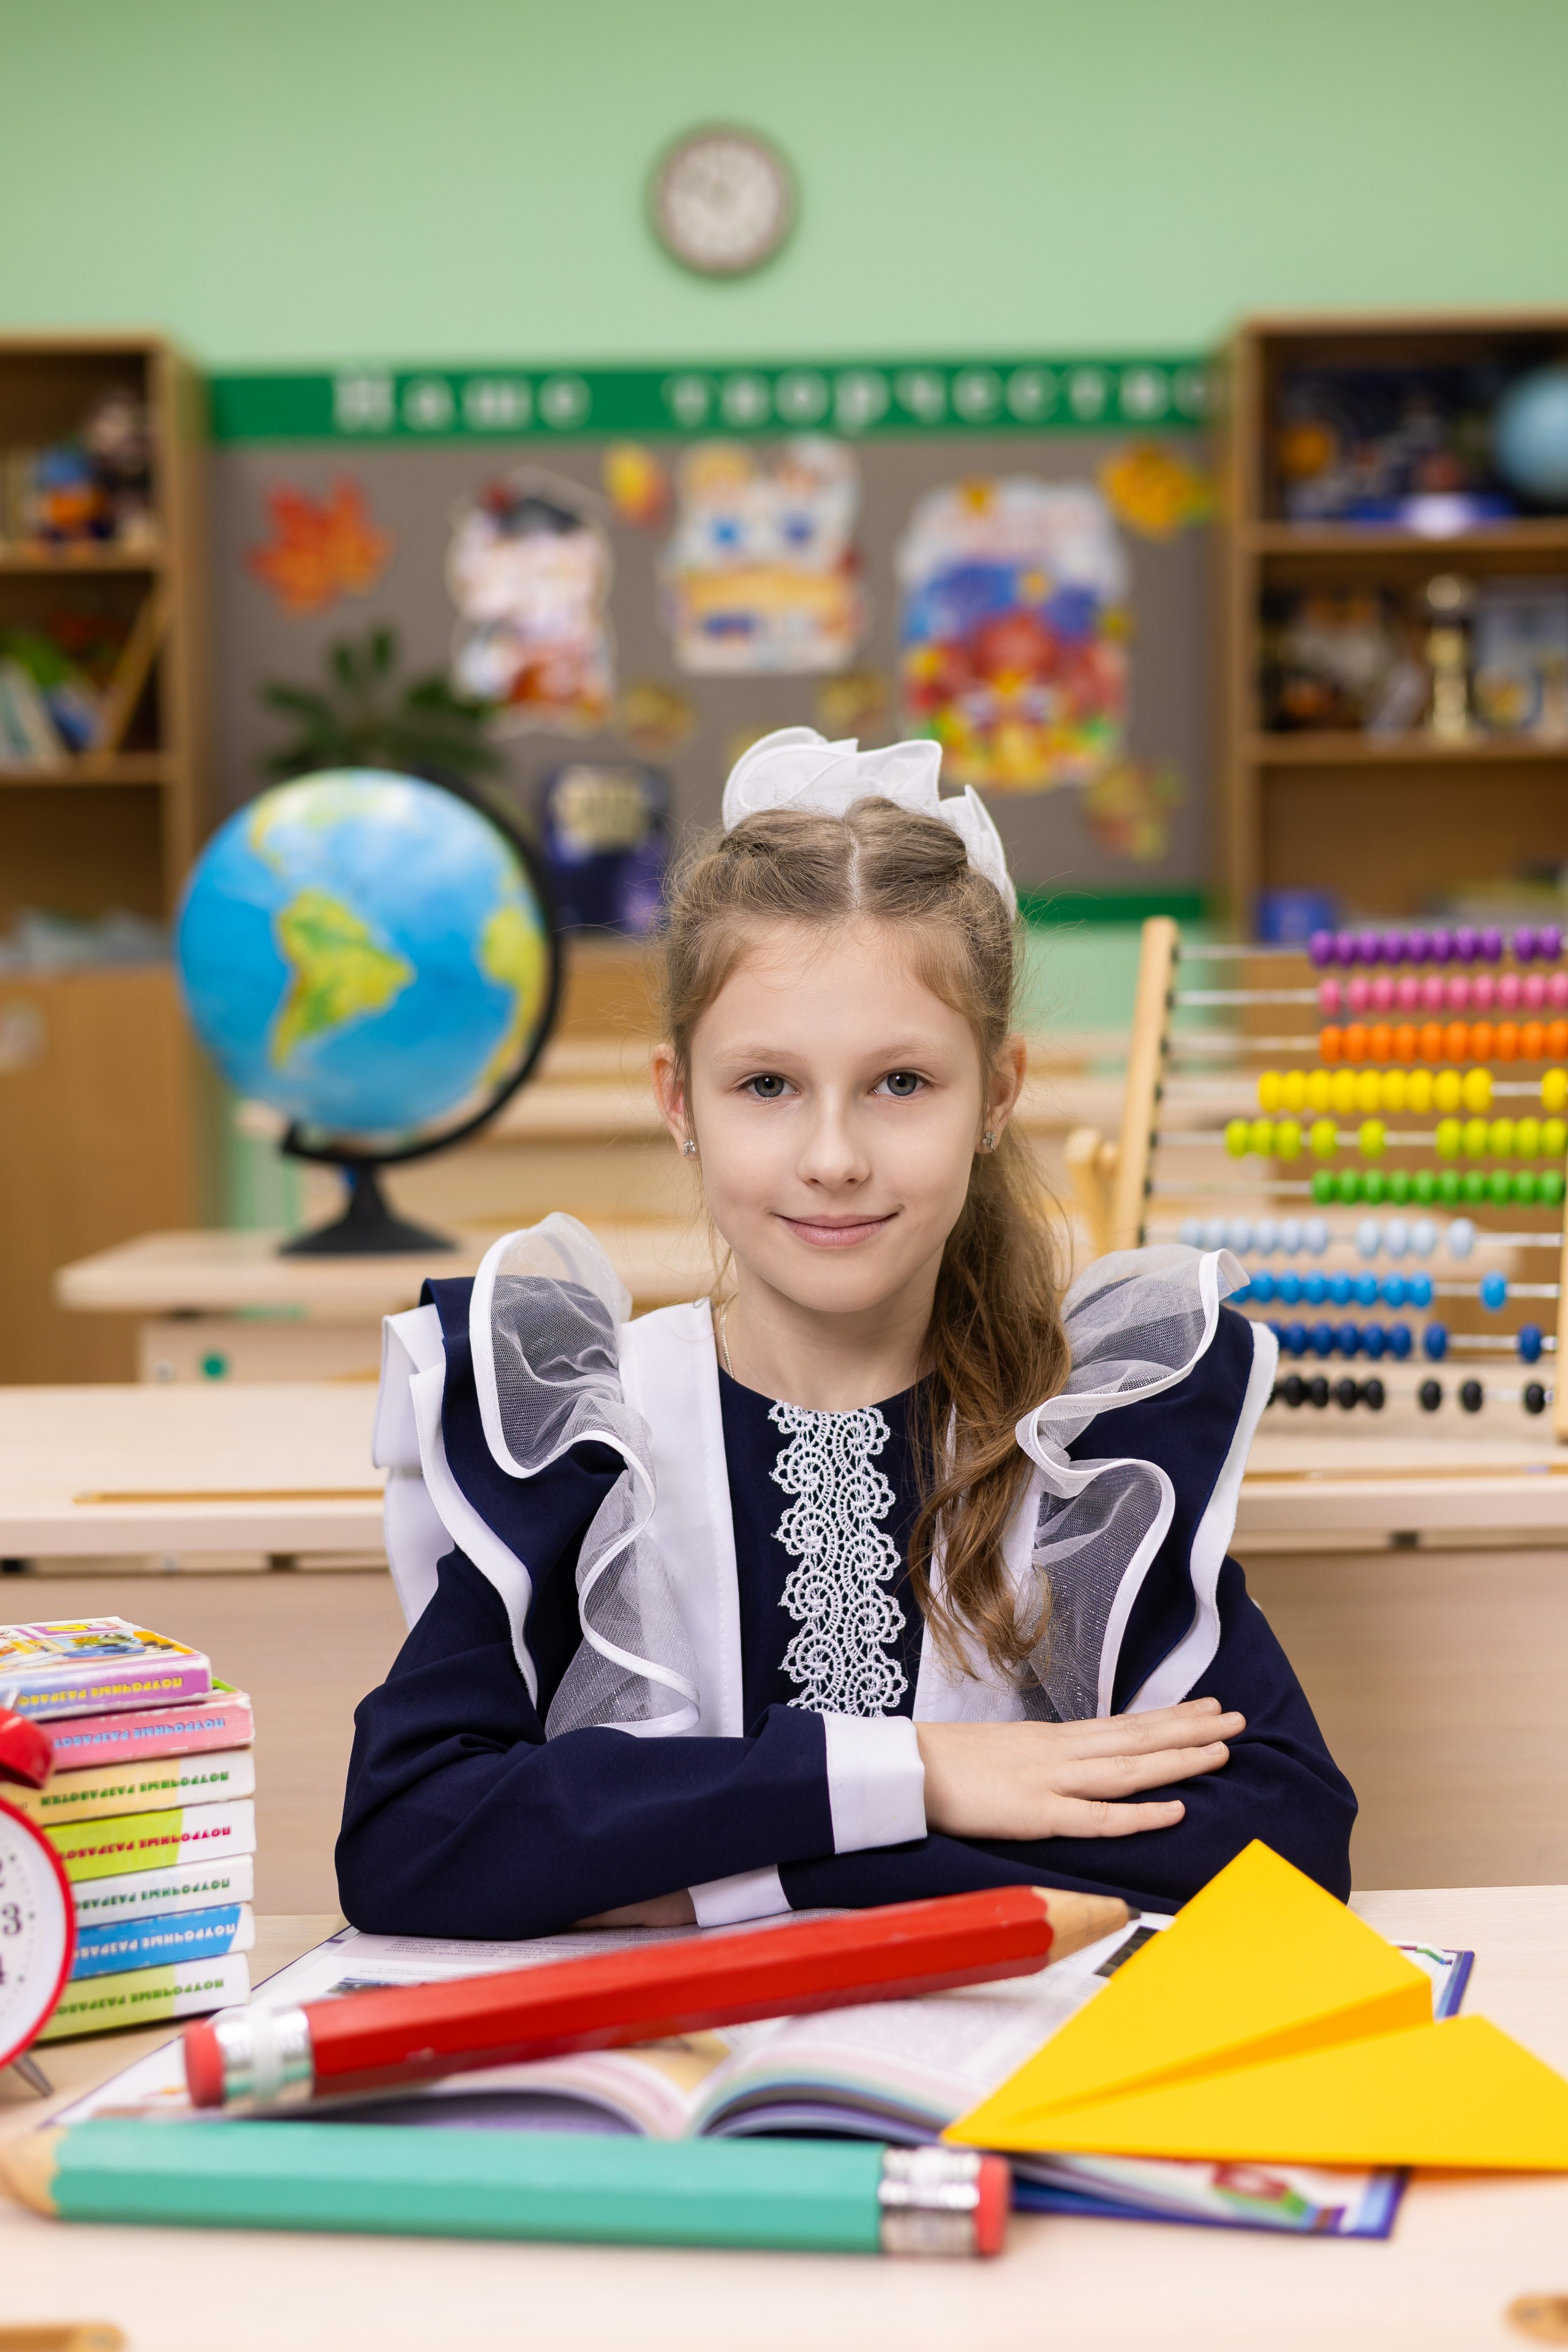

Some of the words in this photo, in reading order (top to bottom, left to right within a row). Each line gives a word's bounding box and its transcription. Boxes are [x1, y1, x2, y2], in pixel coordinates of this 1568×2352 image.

[333, 364, 594, 434] Наше
[19, 1689, 87, 1706] РАЗРАБО
[91, 1676, 183, 1697] ПОУРОЧНЫЕ
[134, 1718, 225, 1738] ПОУРОЧНЫЕ
[54, 1730, 130, 1749] РАЗРАБОТ
[140, 1771, 229, 1792] ПОУРОЧНЫЕ
[40, 1784, 135, 1806] РАЗРАБОТКИ
[139, 1826, 232, 1849] ПОУРОЧНЫЕ
[141, 1878, 230, 1901] ПОУРОЧНЫЕ
[2, 1903, 21, 1936] 3
[143, 1923, 237, 1948] ПОУРОЧНЫЕ
[131, 1978, 224, 2003] ПОУРОЧНЫЕ
[56, 1994, 127, 2015] РАЗРАБО
